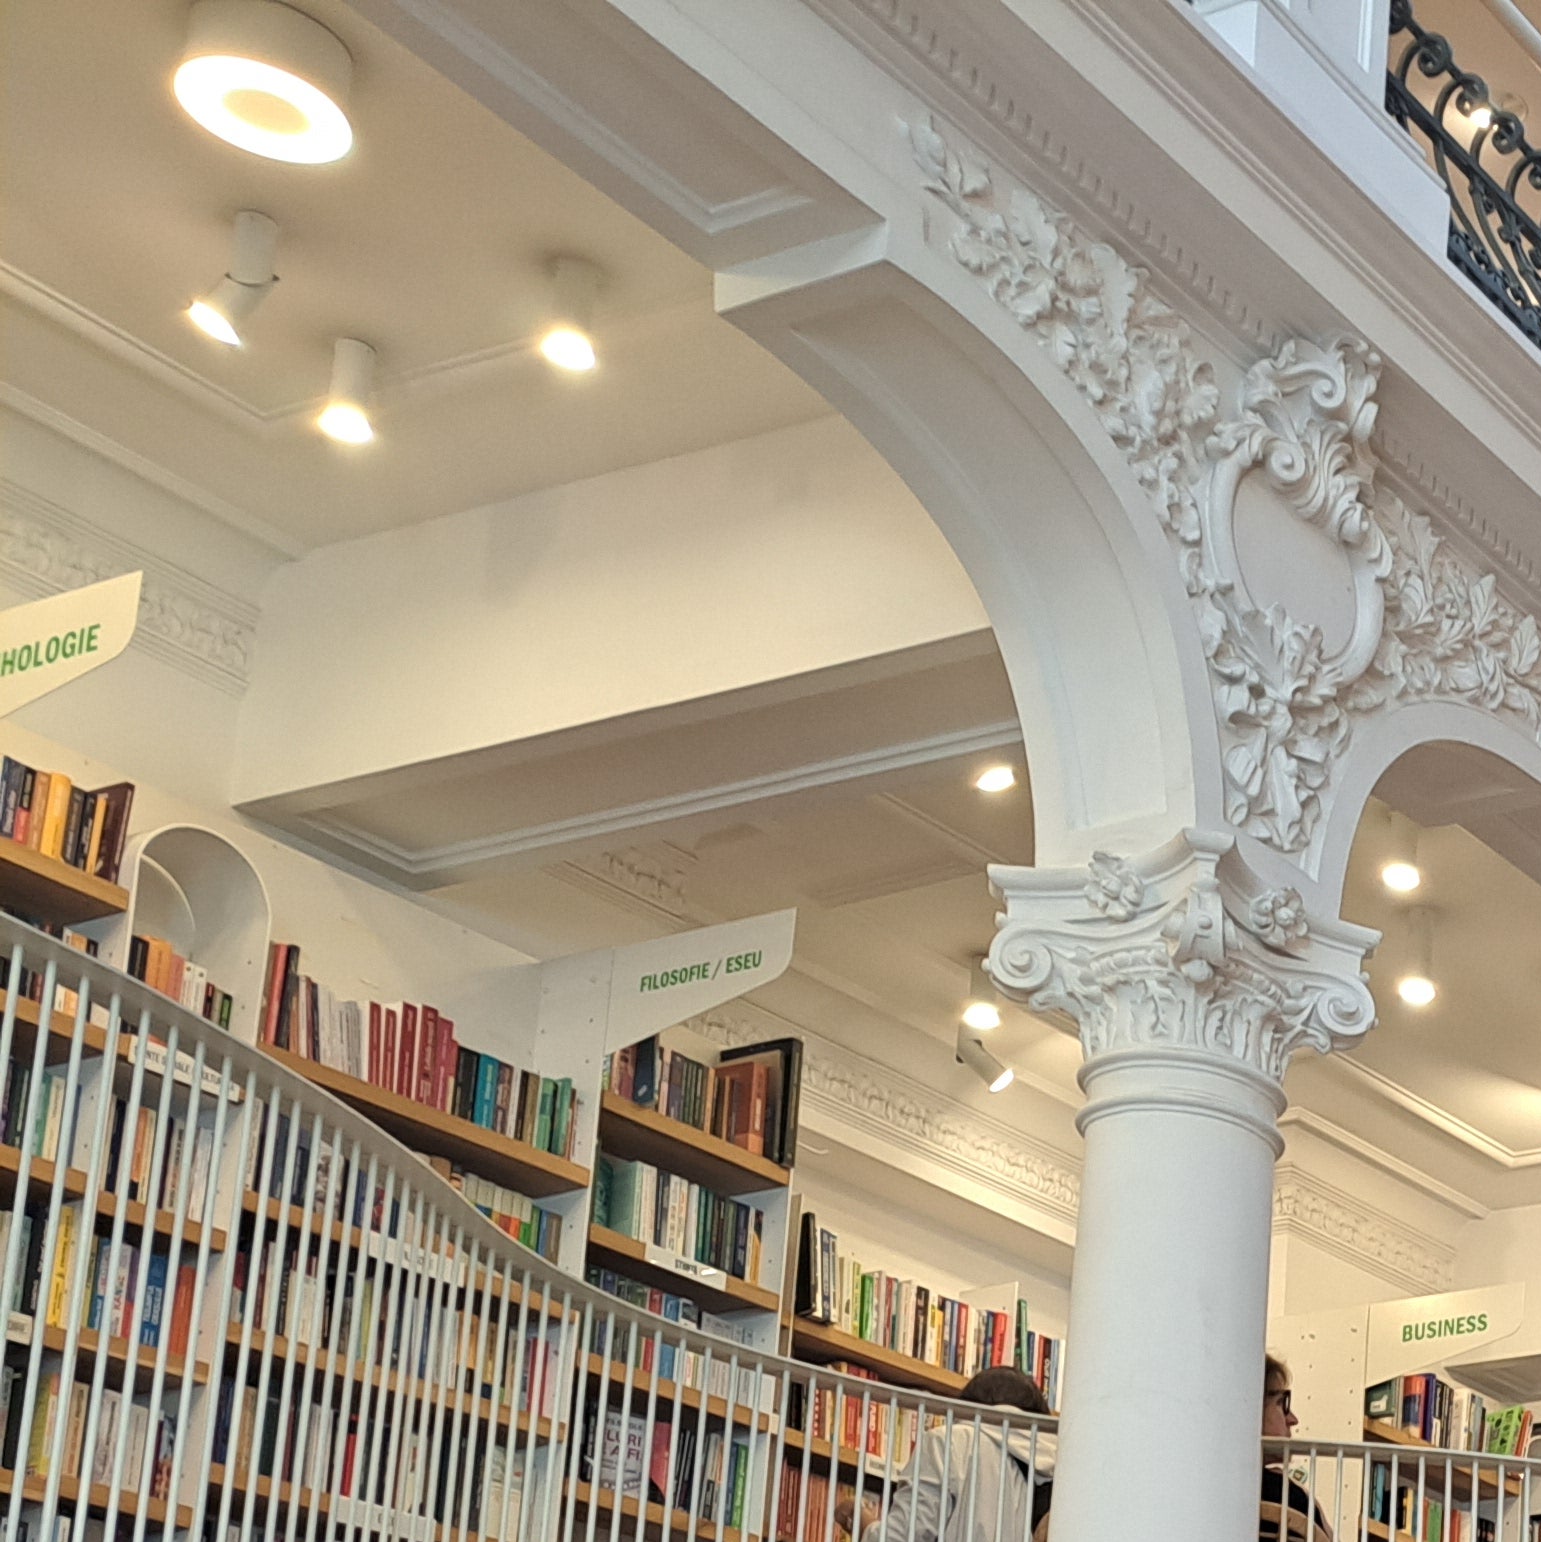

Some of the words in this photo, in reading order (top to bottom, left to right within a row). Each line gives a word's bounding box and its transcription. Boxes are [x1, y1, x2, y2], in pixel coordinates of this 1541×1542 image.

[640, 961, 711, 992] FILOSOFIE
[725, 949, 763, 974] ESEU
[1402, 1313, 1488, 1343] BUSINESS
